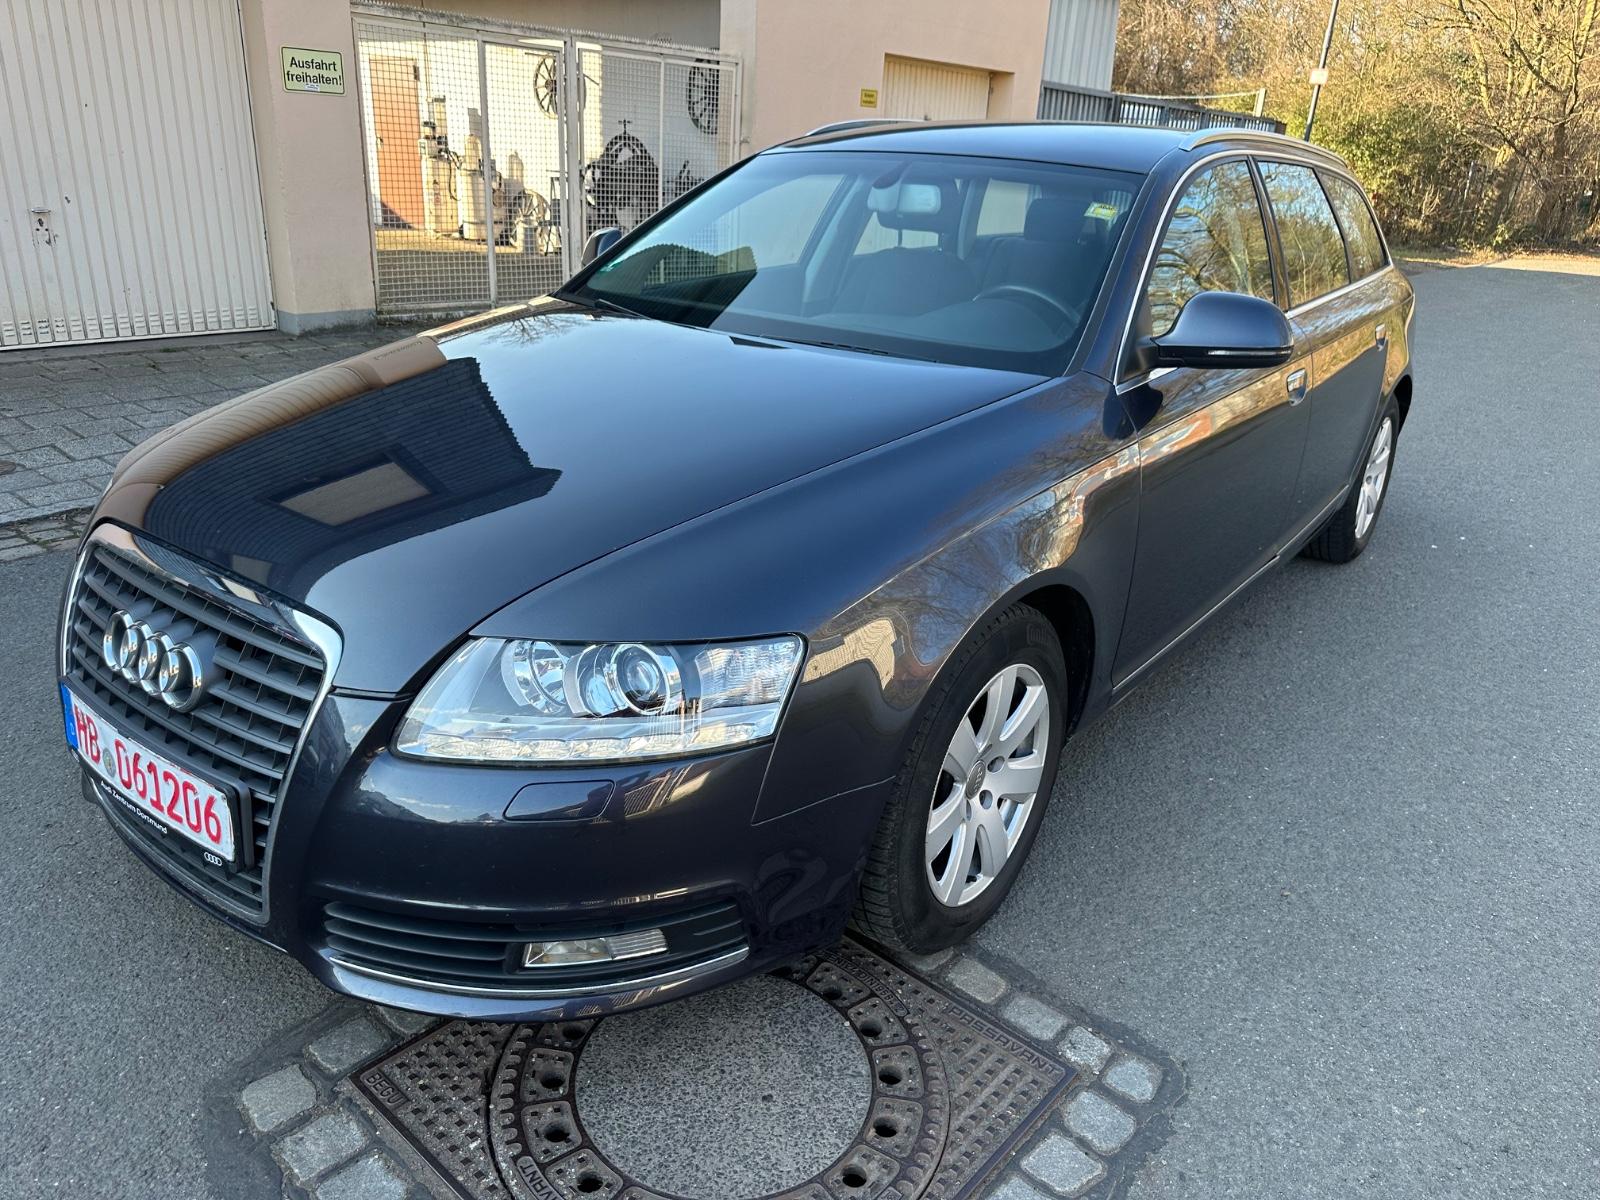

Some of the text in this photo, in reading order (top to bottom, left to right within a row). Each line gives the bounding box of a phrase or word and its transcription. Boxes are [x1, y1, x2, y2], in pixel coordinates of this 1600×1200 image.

[286, 70, 342, 86] freihalten!
[289, 56, 337, 72] Ausfahrt
[74, 704, 221, 844] HB 061206
[113, 790, 136, 813] Zentrum
[135, 807, 167, 834] Dortmund
[949, 1006, 1056, 1074] PASSAVANT
[366, 1072, 403, 1104] BEGU
